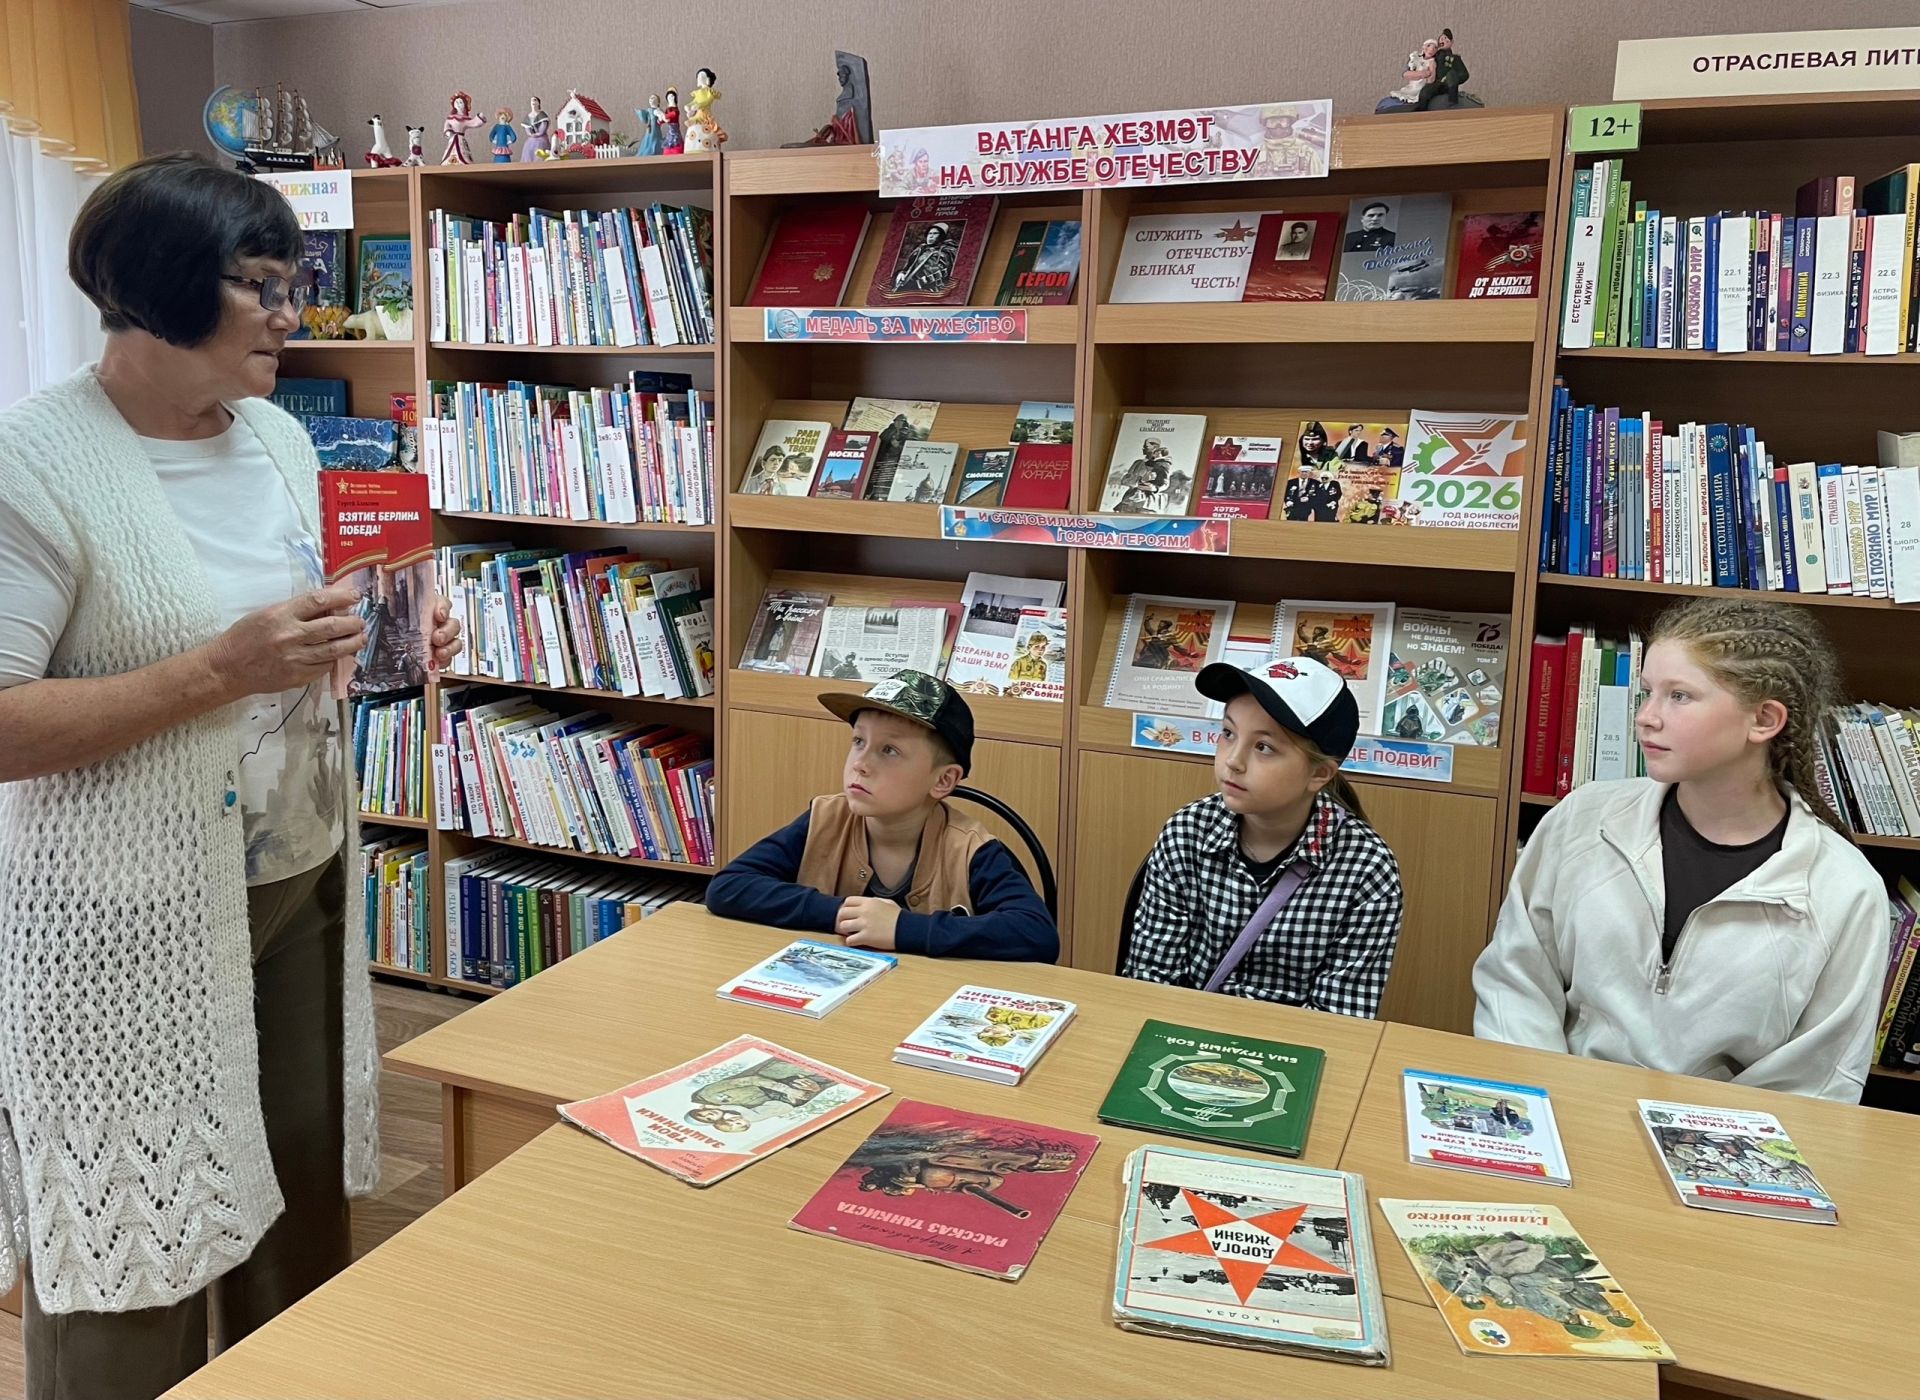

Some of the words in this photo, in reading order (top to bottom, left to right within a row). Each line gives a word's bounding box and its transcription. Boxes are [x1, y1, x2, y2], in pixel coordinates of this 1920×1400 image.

[1693, 49, 1857, 73] ОТРАСЛЕВАЯ
[977, 121, 1100, 154] ВАТАНГА
[1104, 116, 1215, 146] ХЕЗМӘТ
[1589, 117, 1633, 137] 12+
[940, 165, 974, 187] НА
[983, 157, 1088, 186] СЛУЖБЕ
[1095, 148, 1261, 180] ОТЕЧЕСТВУ
[1136, 229, 1202, 242] СЛУЖИТЬ
[1585, 225, 1593, 236] 2
[1690, 246, 1702, 272] МИР
[1129, 263, 1195, 277] ВЕЛИКАЯ
[1661, 266, 1673, 289] МИР
[1822, 272, 1840, 280] 22.3
[1877, 269, 1896, 277] 22.6
[1016, 272, 1071, 287] ГЕРОИ
[1191, 276, 1241, 289] ЧЕСТЬ!
[1475, 278, 1489, 286] ОТ
[1491, 276, 1532, 286] КАЛУГИ
[1469, 287, 1484, 298] ДО
[1486, 285, 1532, 296] БЕРЛИНА
[1572, 261, 1585, 323] ЕСТЕСТВЕННЫЕ
[1584, 280, 1593, 305] НАУКИ
[1688, 275, 1702, 326] ПОЗНАЮ
[1660, 288, 1673, 333] ПОЗНАЮ
[805, 318, 877, 335] МЕДАЛЬ
[881, 318, 905, 334] ЗА
[910, 316, 1017, 335] МУЖЕСТВО
[1688, 328, 1699, 339] Я
[783, 436, 818, 446] ЖИЗНИ
[796, 429, 821, 439] РАДИ
[828, 450, 865, 459] МОСКВА
[691, 448, 699, 480] ДВИЖЕНИЯ
[1019, 460, 1070, 470] МАМАЕВ
[1555, 452, 1564, 476] МИРА
[1608, 458, 1616, 482] МИРА
[1652, 432, 1661, 509] ПЕРВОПРОХОДЦЫ
[620, 464, 628, 498] ТРАНСПОРТ
[1021, 470, 1064, 481] КУРГАН
[1411, 480, 1519, 510] 2026
[1554, 477, 1564, 504] АТЛАС
[1714, 472, 1723, 501] МИРА
[1826, 480, 1837, 499] МИРА
[694, 481, 702, 518] ДОРОЖНОГО
[1864, 494, 1878, 521] МИР
[338, 511, 376, 522] ВЗЯТИЕ
[378, 511, 419, 521] БЕРЛИНА
[979, 512, 988, 521] И
[991, 512, 1098, 528] СТАНОВИЛИСЬ
[1443, 512, 1461, 520] ГОД
[1463, 513, 1519, 521] ВОИНСКОЙ
[1827, 498, 1839, 526] СТРАНЫ
[339, 525, 381, 535] ПОБЕДА!
[1467, 521, 1518, 529] ДОБЛЕСТИ
[1673, 509, 1681, 558] ГЕОГРАФИЧЕСКИЕ
[1716, 505, 1727, 556] СТОЛИЦЫ
[1900, 521, 1911, 529] 28
[1057, 530, 1115, 544] ГОРОДА
[1120, 532, 1190, 548] ГЕРОЯМИ
[1783, 532, 1791, 551] АТЛАС
[1850, 526, 1865, 573] ПОЗНАЮ
[1867, 524, 1883, 575] ПОЗНАЮ
[1719, 557, 1729, 577] ВСЕ
[1784, 552, 1792, 575] МАЛЫЙ
[1870, 577, 1884, 587] Я
[609, 608, 619, 617] 75
[646, 611, 657, 620] 87
[1403, 623, 1451, 635] ВОЙНЫ
[1420, 642, 1465, 654] ЗНАЕМ!
[663, 650, 673, 668] ВЕСТИ
[956, 657, 982, 666] НАШИ
[1538, 692, 1551, 728] КНИГА
[434, 750, 444, 758] 85
[463, 752, 474, 762] 92
[1373, 751, 1444, 768] ПОДВИГ
[516, 893, 524, 914] ДЕТЕЙ
[449, 950, 458, 976] ХОЧУ
[1891, 949, 1914, 1005] ЭНЦИКЛОПЕДИЯ
[1199, 1041, 1266, 1058] ТРУДНЫЙ
[1269, 1053, 1298, 1064] БЫЛ
[635, 1108, 726, 1149] ЗАЩИТНИКИ
[648, 1123, 687, 1143] ТВОИ
[1679, 1117, 1748, 1131] РАССКАЗЫ
[1420, 1134, 1466, 1146] КУРТКА
[1470, 1141, 1543, 1157] ОТЦОВСКАЯ
[1702, 1186, 1736, 1196] ЧТЕНИЕ
[1740, 1190, 1807, 1204] ВНЕКЛАССНОЕ
[836, 1201, 924, 1231] ТАНКИСТА
[929, 1222, 1008, 1248] РАССКАЗ
[1214, 1228, 1271, 1246] ЖИЗНИ
[1211, 1240, 1275, 1260] ДОРОГА
[1205, 1308, 1262, 1322] ХОДЗА
